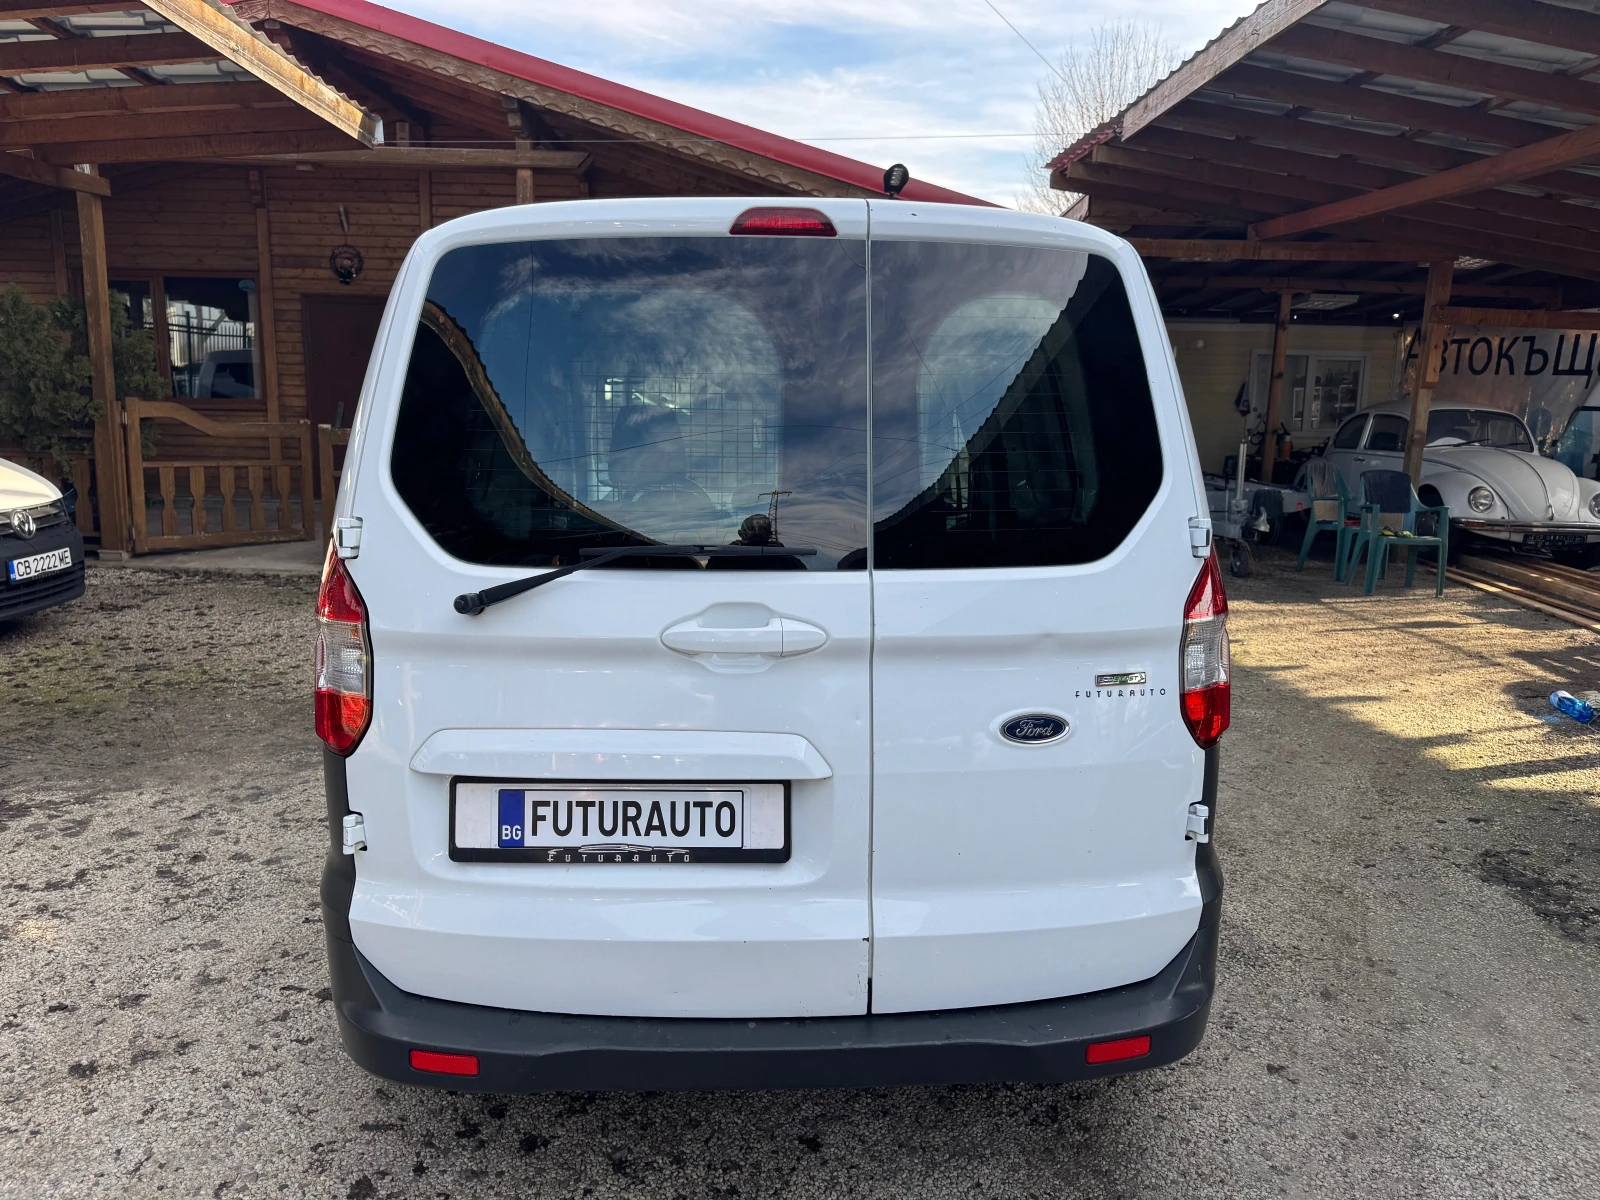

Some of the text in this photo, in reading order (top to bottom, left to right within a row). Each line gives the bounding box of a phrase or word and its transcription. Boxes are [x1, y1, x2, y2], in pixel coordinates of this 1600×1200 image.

[1404, 327, 1600, 390] АТОКЪЩ
[16, 560, 32, 577] CB
[33, 553, 58, 573] 2222
[1075, 688, 1166, 698] FUTURAUTO
[1015, 719, 1054, 737] Ford
[531, 800, 736, 838] FUTURAUTO
[501, 825, 522, 841] BG
[547, 854, 690, 863] FUTURAUTO
